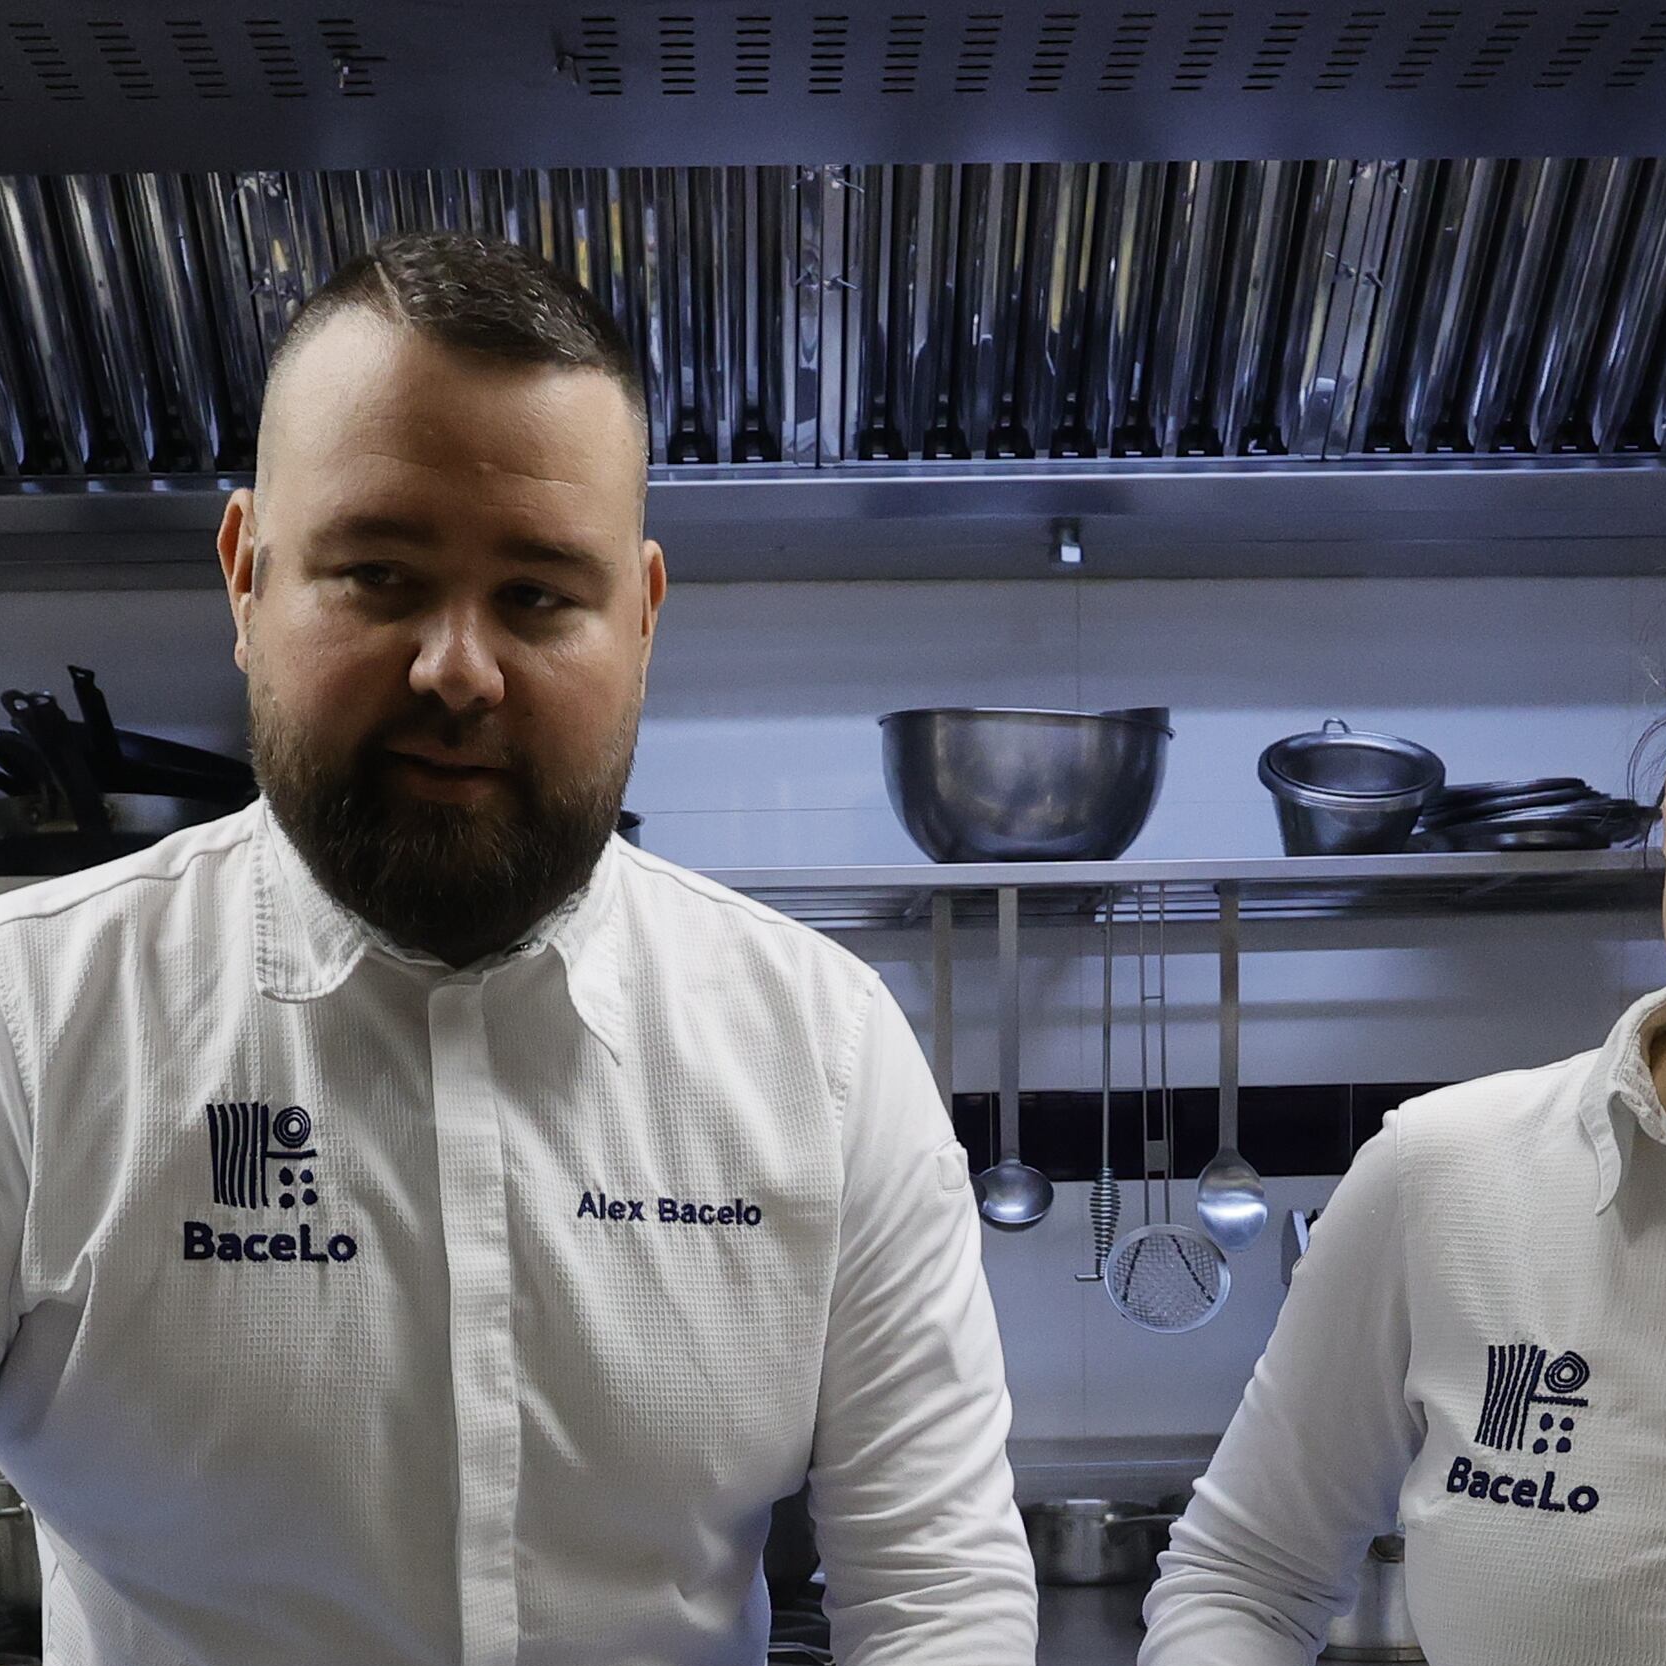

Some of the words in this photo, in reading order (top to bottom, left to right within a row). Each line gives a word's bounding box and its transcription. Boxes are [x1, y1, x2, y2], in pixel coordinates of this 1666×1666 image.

[576, 1191, 646, 1223] Alex
[657, 1197, 763, 1227] Bacelo
[182, 1220, 358, 1265] BaceLo
[1446, 1456, 1601, 1515] BaceLo
